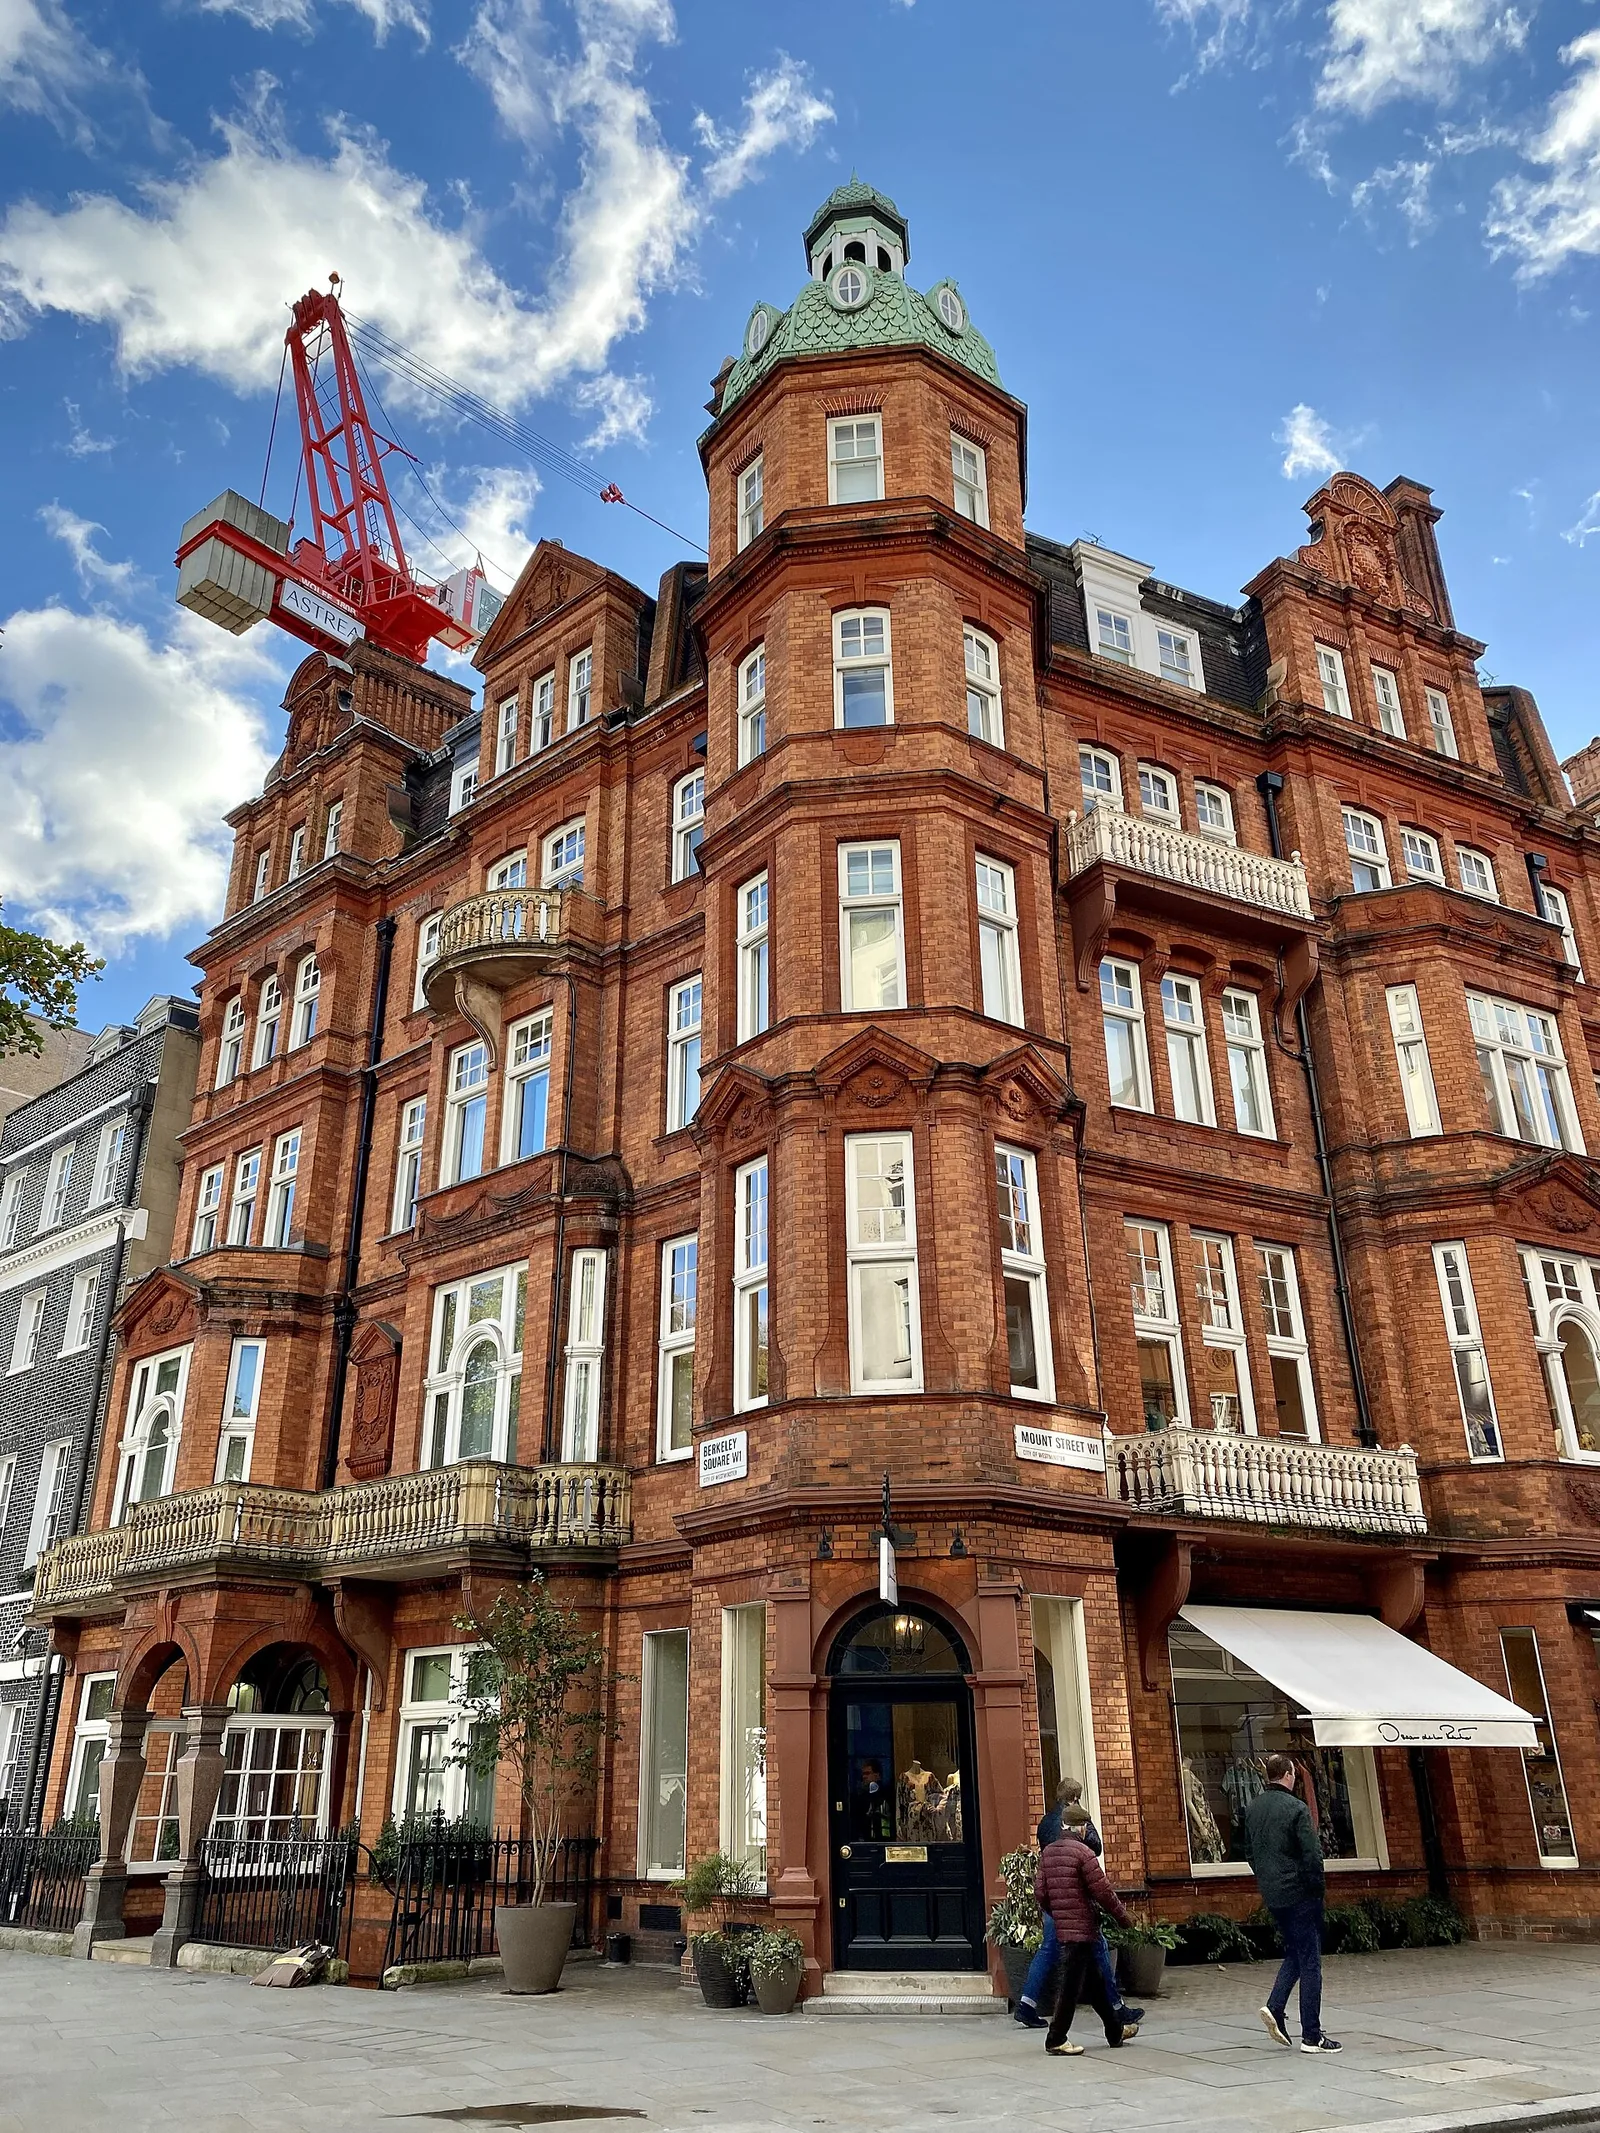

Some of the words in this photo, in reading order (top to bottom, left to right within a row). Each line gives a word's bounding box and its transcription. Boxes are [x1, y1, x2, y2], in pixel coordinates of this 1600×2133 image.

[300, 577, 333, 600] WOLFF
[466, 573, 475, 602] WOLFF
[286, 590, 359, 637] ASTREA
[703, 1438, 737, 1457] BERKELEY
[1021, 1431, 1052, 1447] MOUNT
[1056, 1437, 1084, 1453] STREET
[1087, 1443, 1099, 1455] W1
[704, 1453, 730, 1470] SQUARE
[732, 1451, 741, 1463] W1
[307, 1751, 318, 1766] 34
